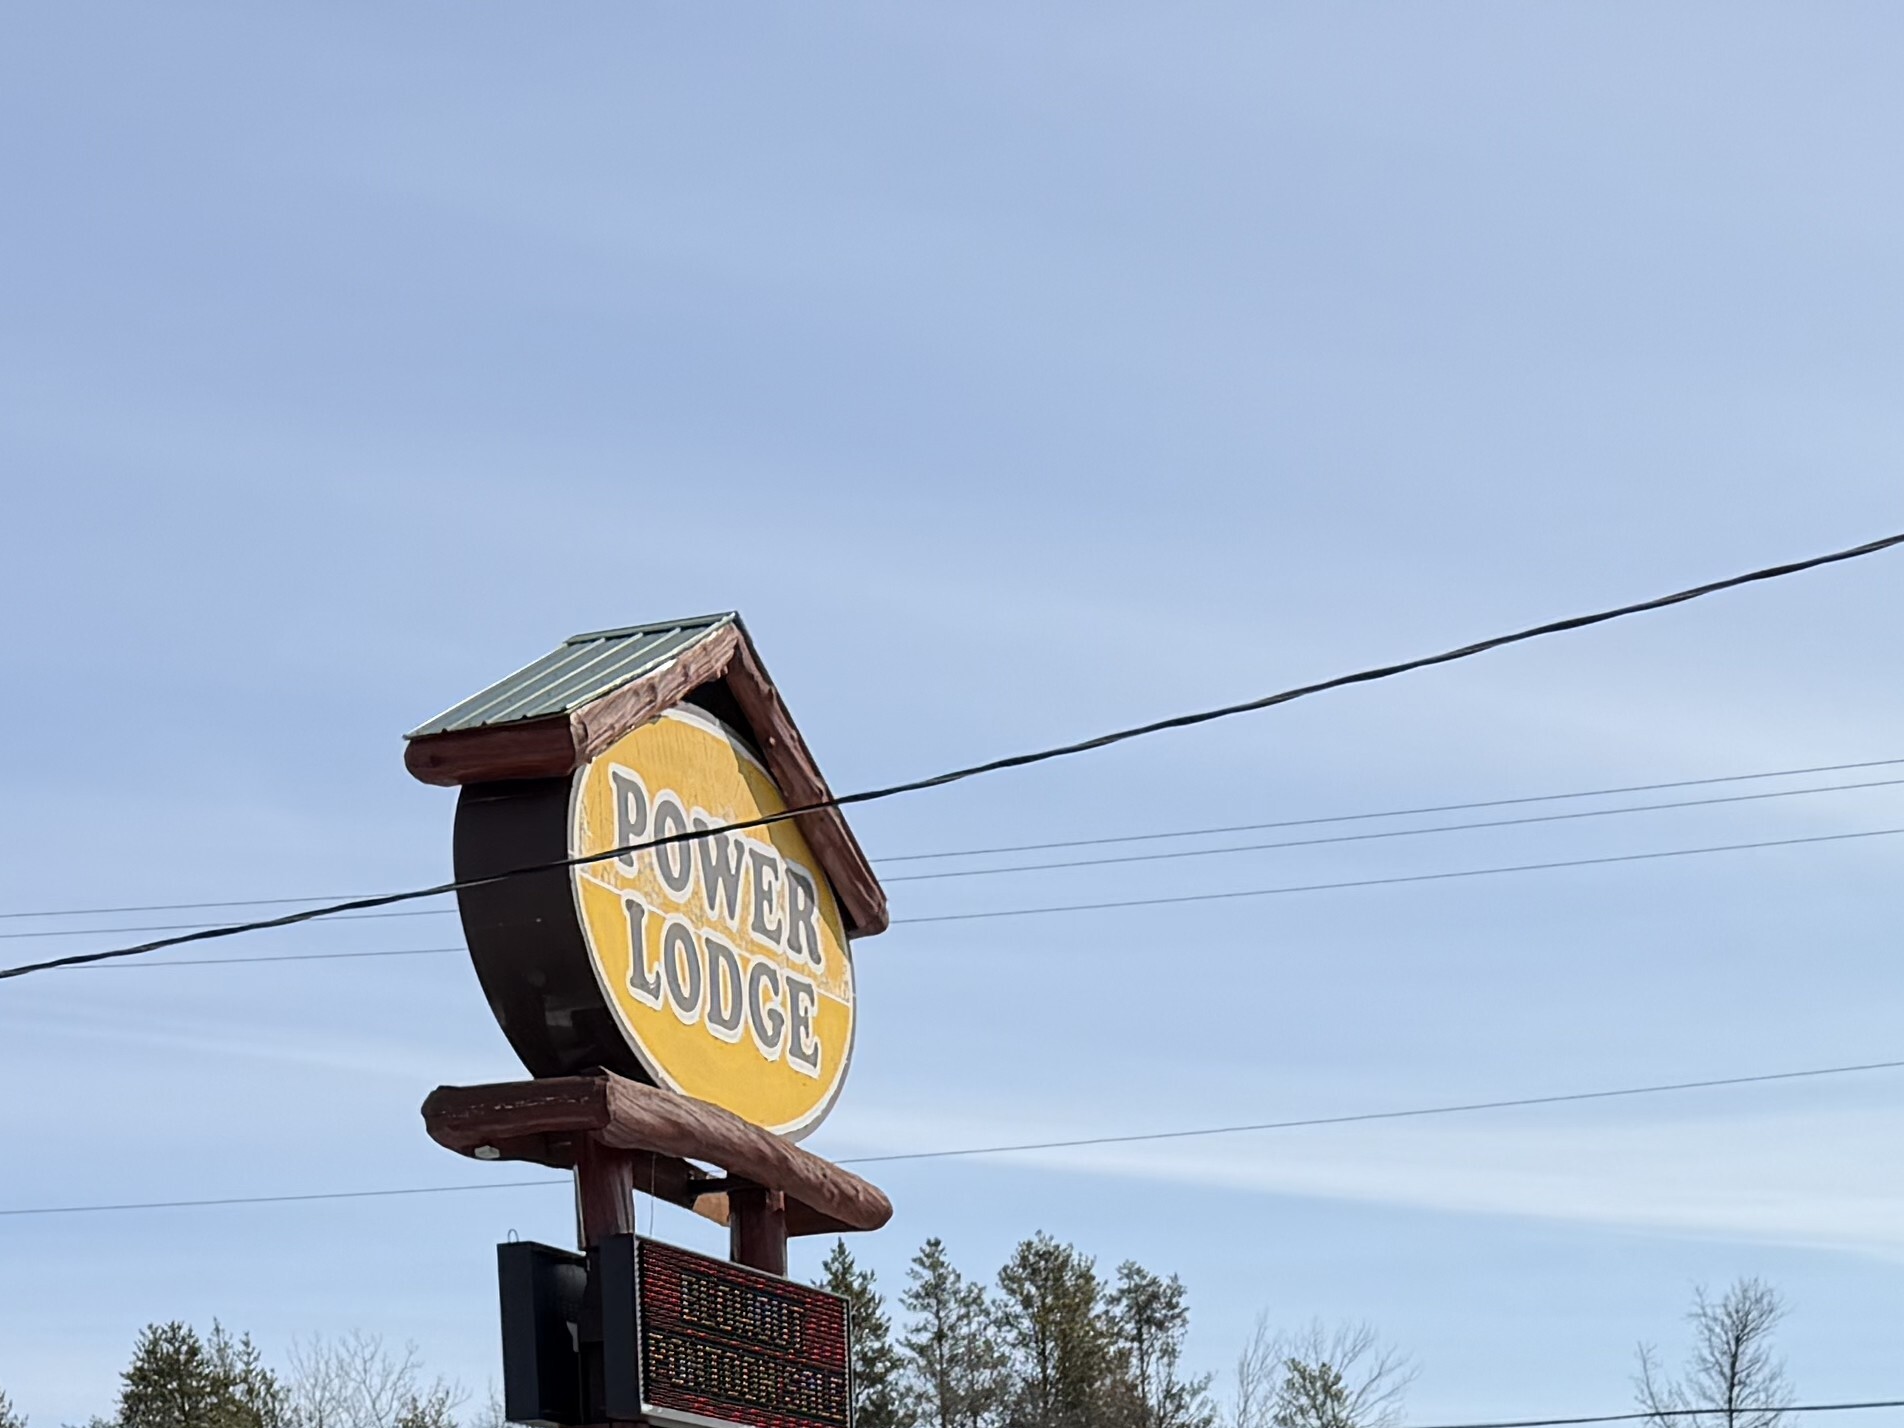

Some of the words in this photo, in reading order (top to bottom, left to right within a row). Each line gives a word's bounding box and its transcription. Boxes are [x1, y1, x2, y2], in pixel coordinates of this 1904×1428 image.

[609, 763, 823, 972] POWER
[624, 896, 821, 1077] LODGE
[681, 1273, 804, 1350] BLOWOUT
[784, 1365, 843, 1420] SALE
